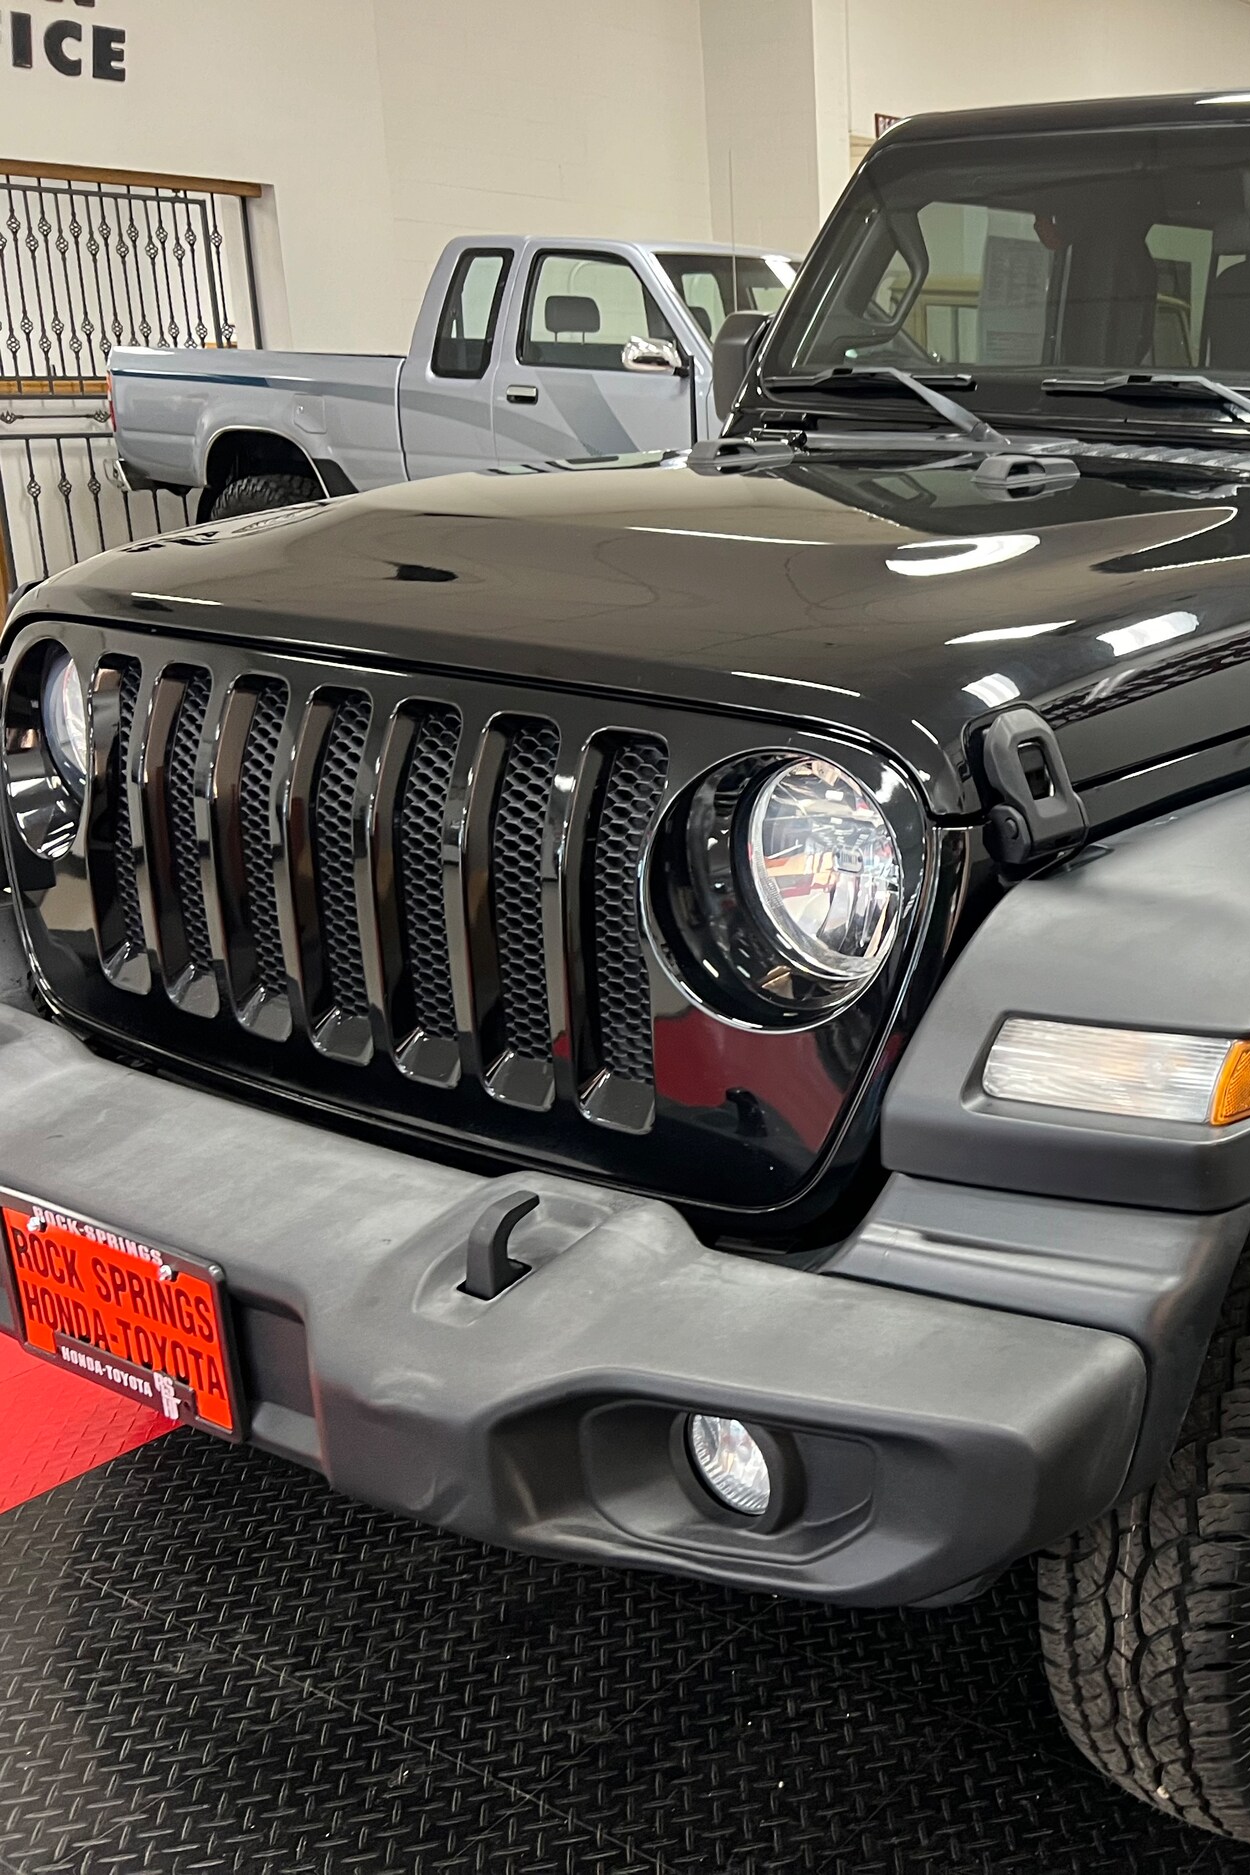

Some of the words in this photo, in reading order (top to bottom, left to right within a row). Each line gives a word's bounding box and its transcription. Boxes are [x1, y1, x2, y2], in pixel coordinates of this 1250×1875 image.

[0, 11, 126, 82] ICE
[10, 1226, 84, 1292] ROCK
[91, 1257, 214, 1343] SPRINGS
[22, 1280, 226, 1400] HONDA-TOYOTA
[61, 1345, 153, 1398] HONDA-TOYOTA
